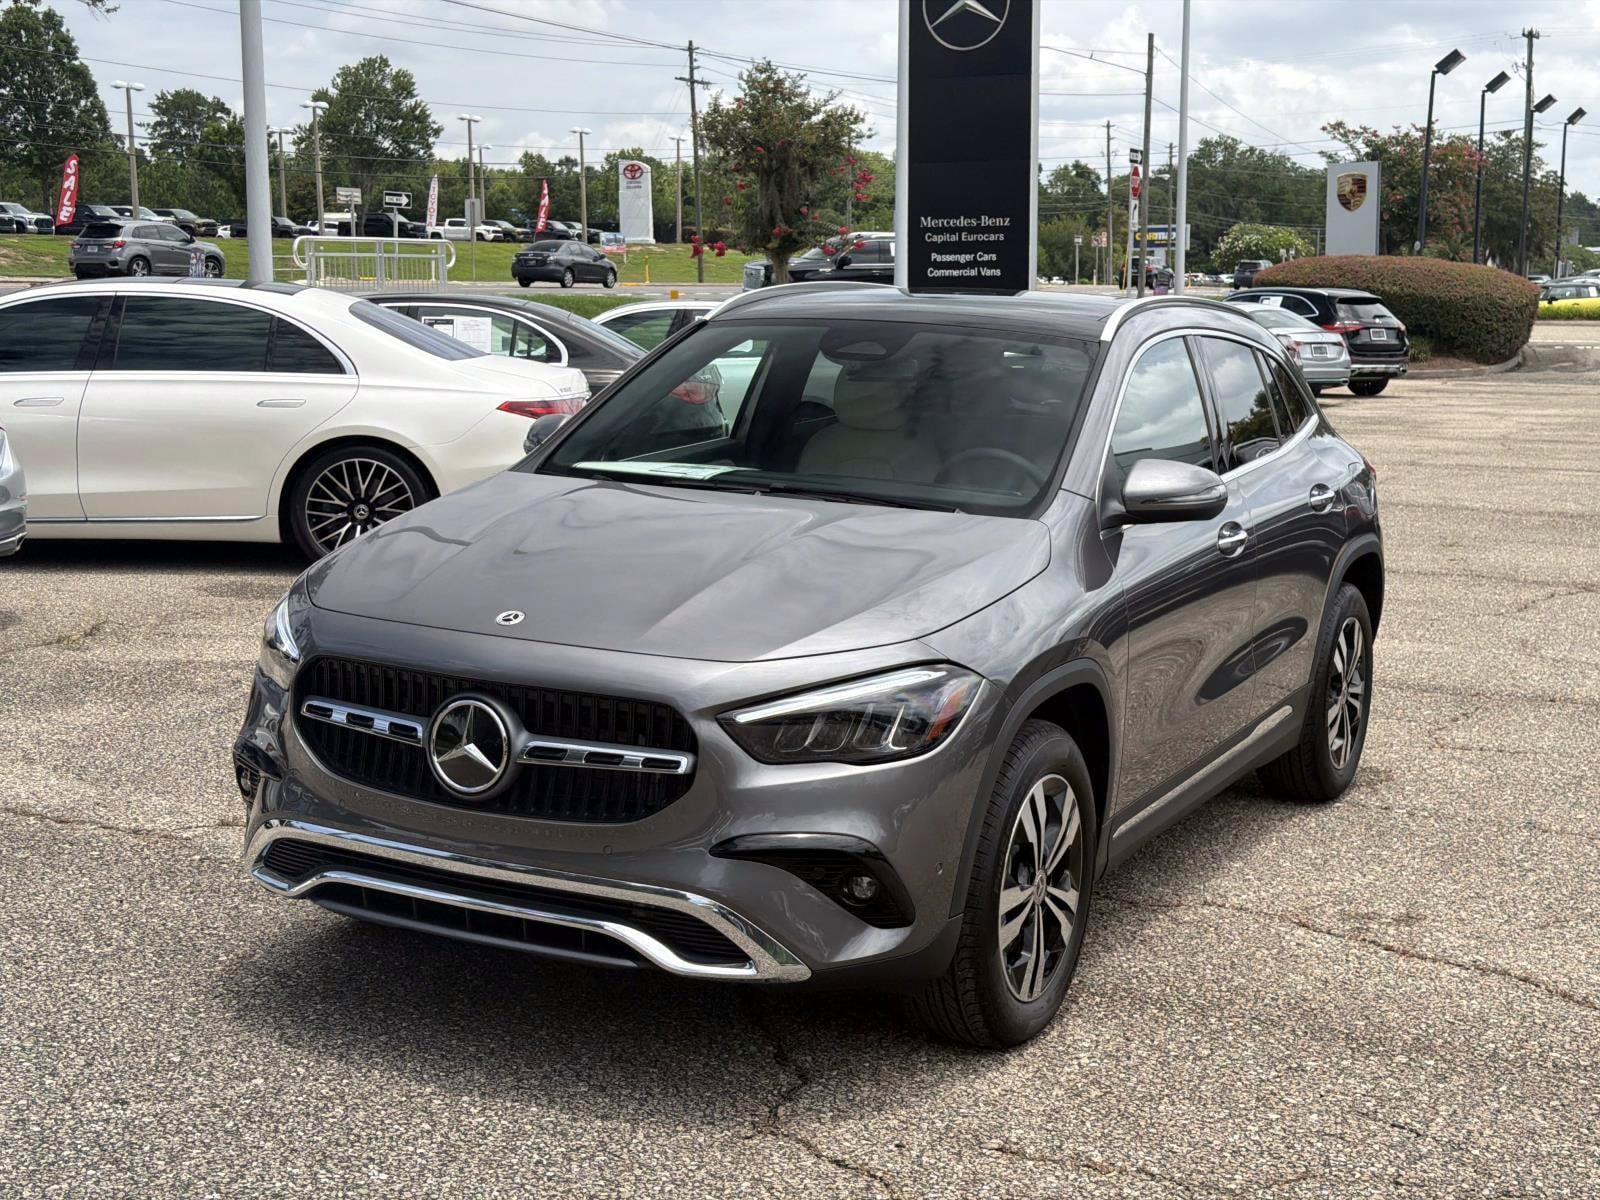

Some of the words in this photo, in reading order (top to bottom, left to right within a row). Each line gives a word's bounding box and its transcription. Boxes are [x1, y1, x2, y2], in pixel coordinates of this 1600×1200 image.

[59, 159, 77, 222] SALE
[920, 215, 1011, 227] Mercedes-Benz
[925, 232, 959, 243] Capital
[961, 232, 1005, 241] Eurocars
[931, 252, 974, 263] Passenger
[976, 252, 997, 261] Cars
[927, 267, 978, 277] Commercial
[979, 267, 1001, 276] Vans
